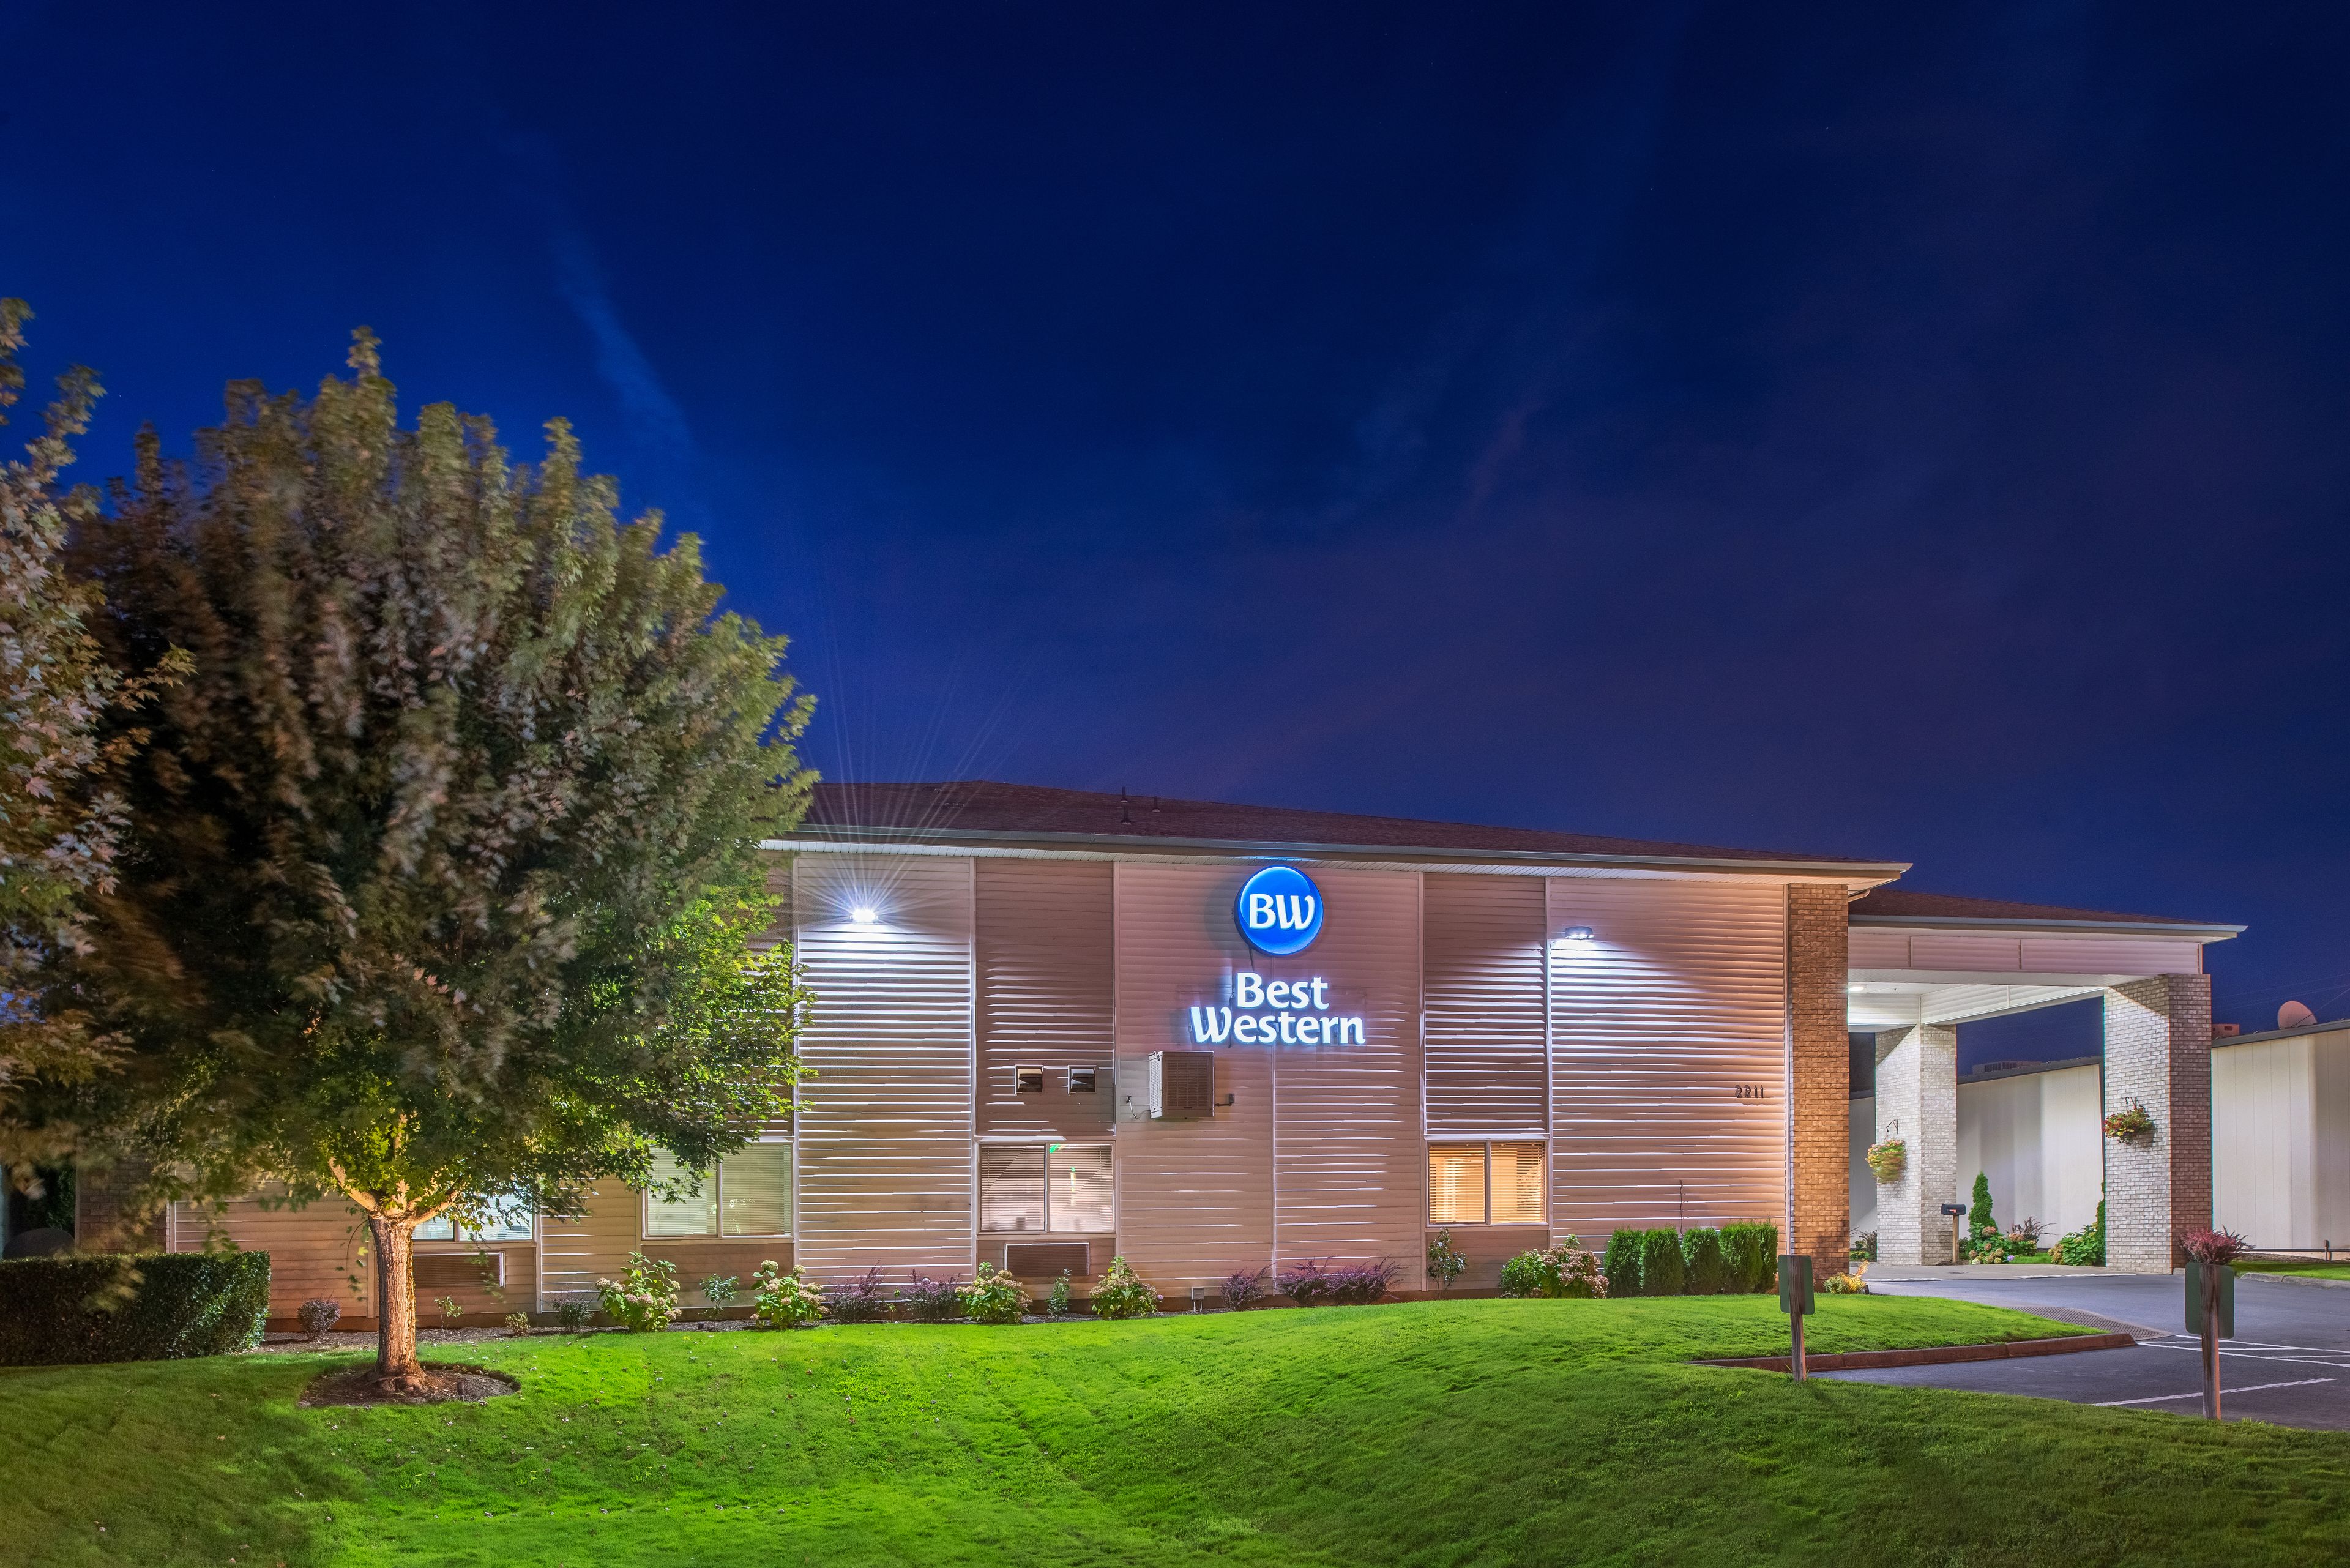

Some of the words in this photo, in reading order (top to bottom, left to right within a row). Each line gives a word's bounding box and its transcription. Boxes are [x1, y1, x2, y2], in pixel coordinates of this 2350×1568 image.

[1249, 894, 1315, 930] BW
[1236, 972, 1329, 1010] Best
[1190, 1006, 1366, 1045] Western
[1736, 1086, 1764, 1098] 2211
